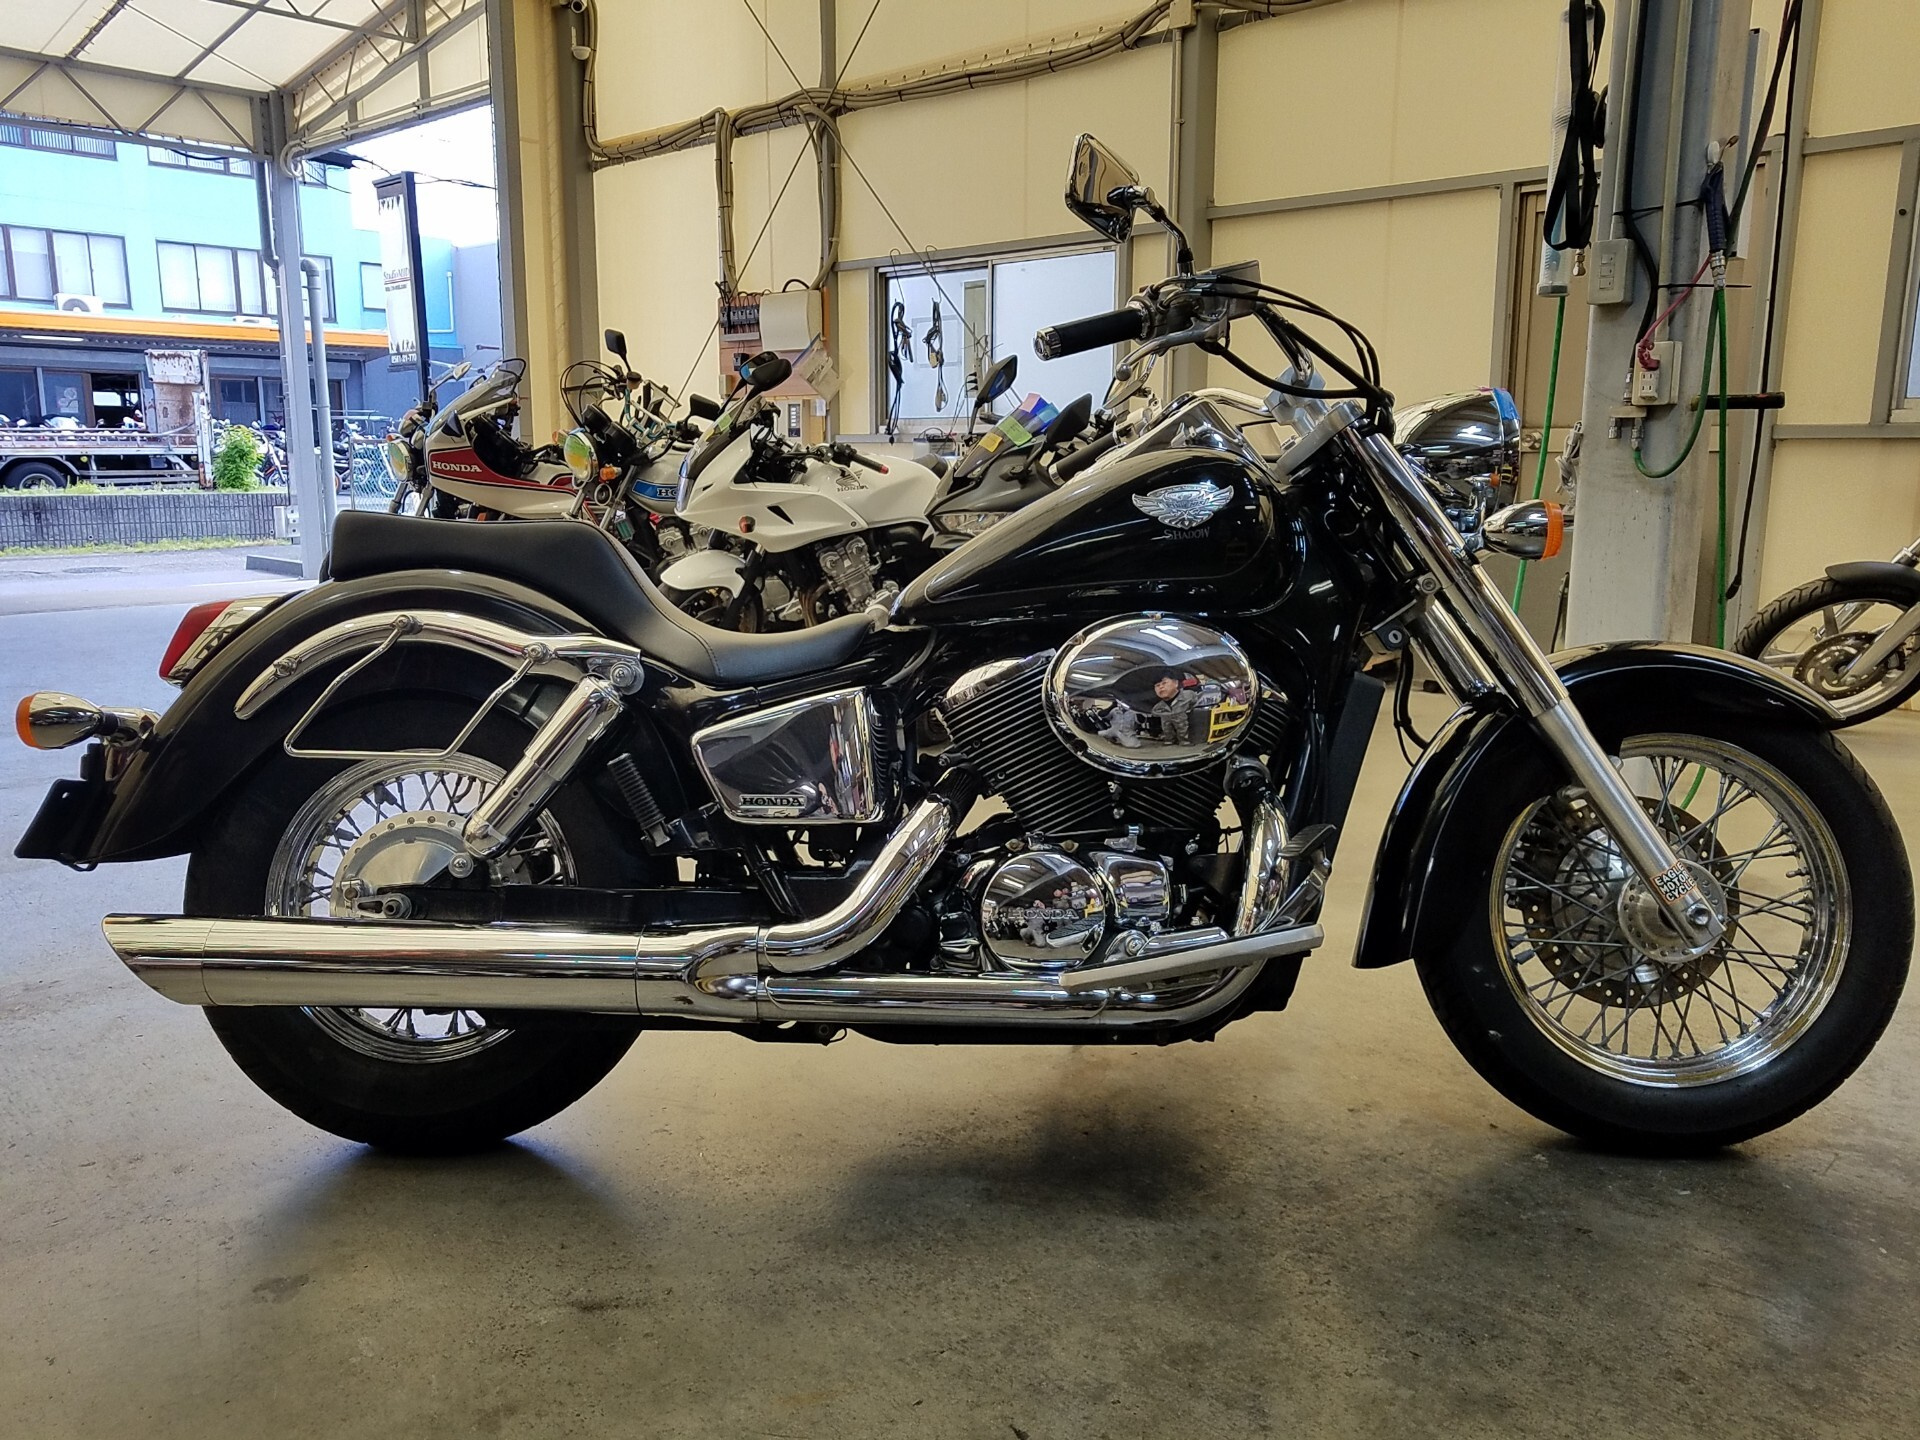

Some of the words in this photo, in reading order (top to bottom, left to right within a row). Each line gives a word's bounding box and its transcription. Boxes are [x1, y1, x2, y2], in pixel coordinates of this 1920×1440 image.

[432, 461, 483, 473] HONDA
[1163, 526, 1211, 540] SHADOW
[742, 797, 804, 807] HONDA
[1654, 861, 1684, 886] EAGLE
[1660, 870, 1690, 895] MOTOR
[1666, 877, 1696, 901] CYCLE
[1007, 908, 1080, 920] HONDA
